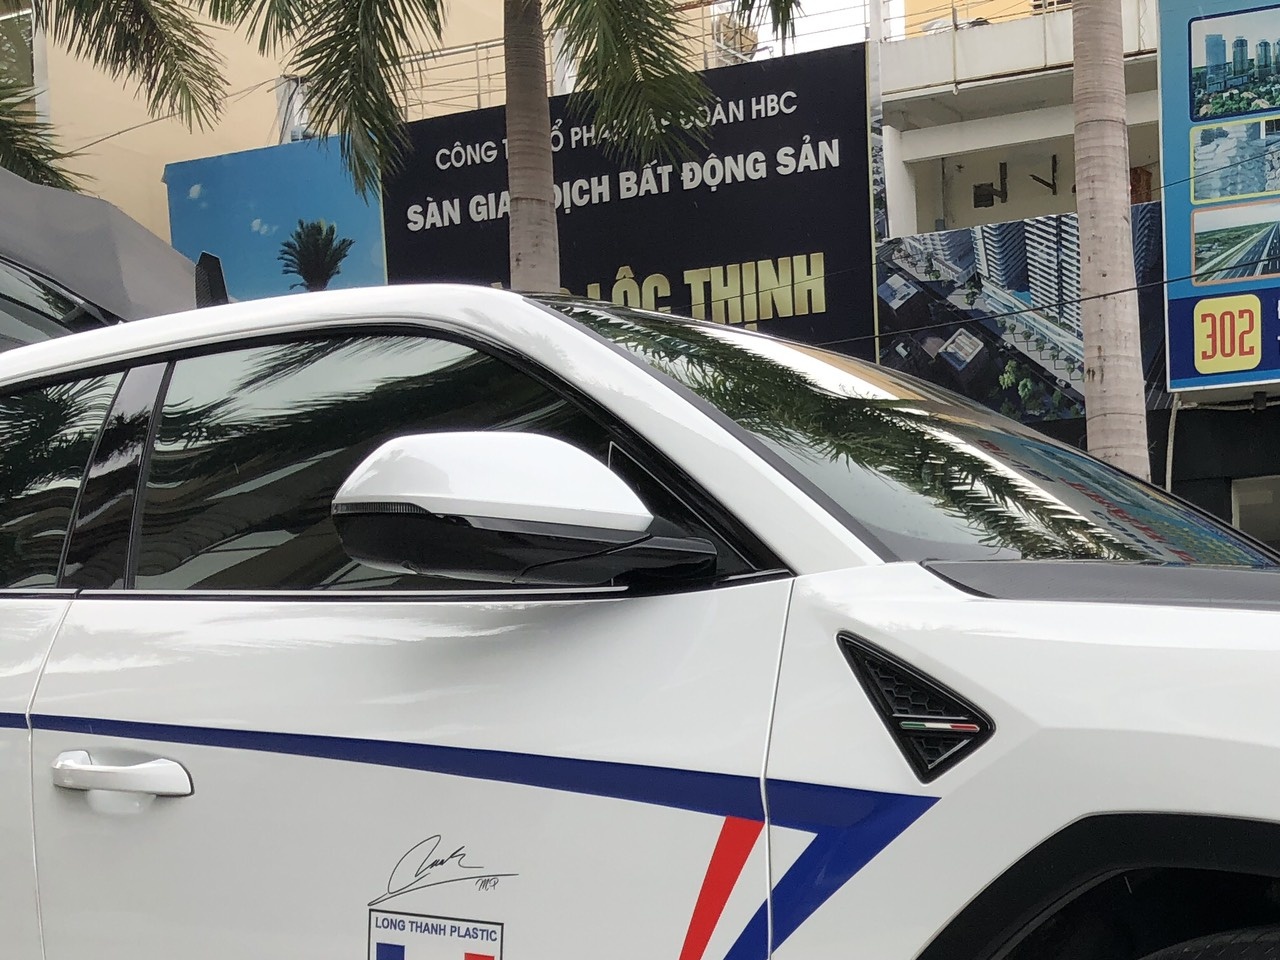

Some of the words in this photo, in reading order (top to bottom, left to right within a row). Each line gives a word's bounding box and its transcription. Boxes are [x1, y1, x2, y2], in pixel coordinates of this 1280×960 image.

[436, 141, 497, 170] CÔNG
[750, 90, 798, 120] HBC
[407, 196, 460, 231] SÀN
[468, 197, 511, 222] GIA
[619, 159, 672, 199] BẤT
[680, 150, 767, 193] ĐỘNG
[775, 135, 841, 176] SẢN
[684, 252, 827, 331] THỊNH
[1200, 308, 1255, 360] 302
[375, 917, 406, 931] LONG
[408, 920, 447, 936] THANH
[449, 925, 498, 942] PLASTIC
